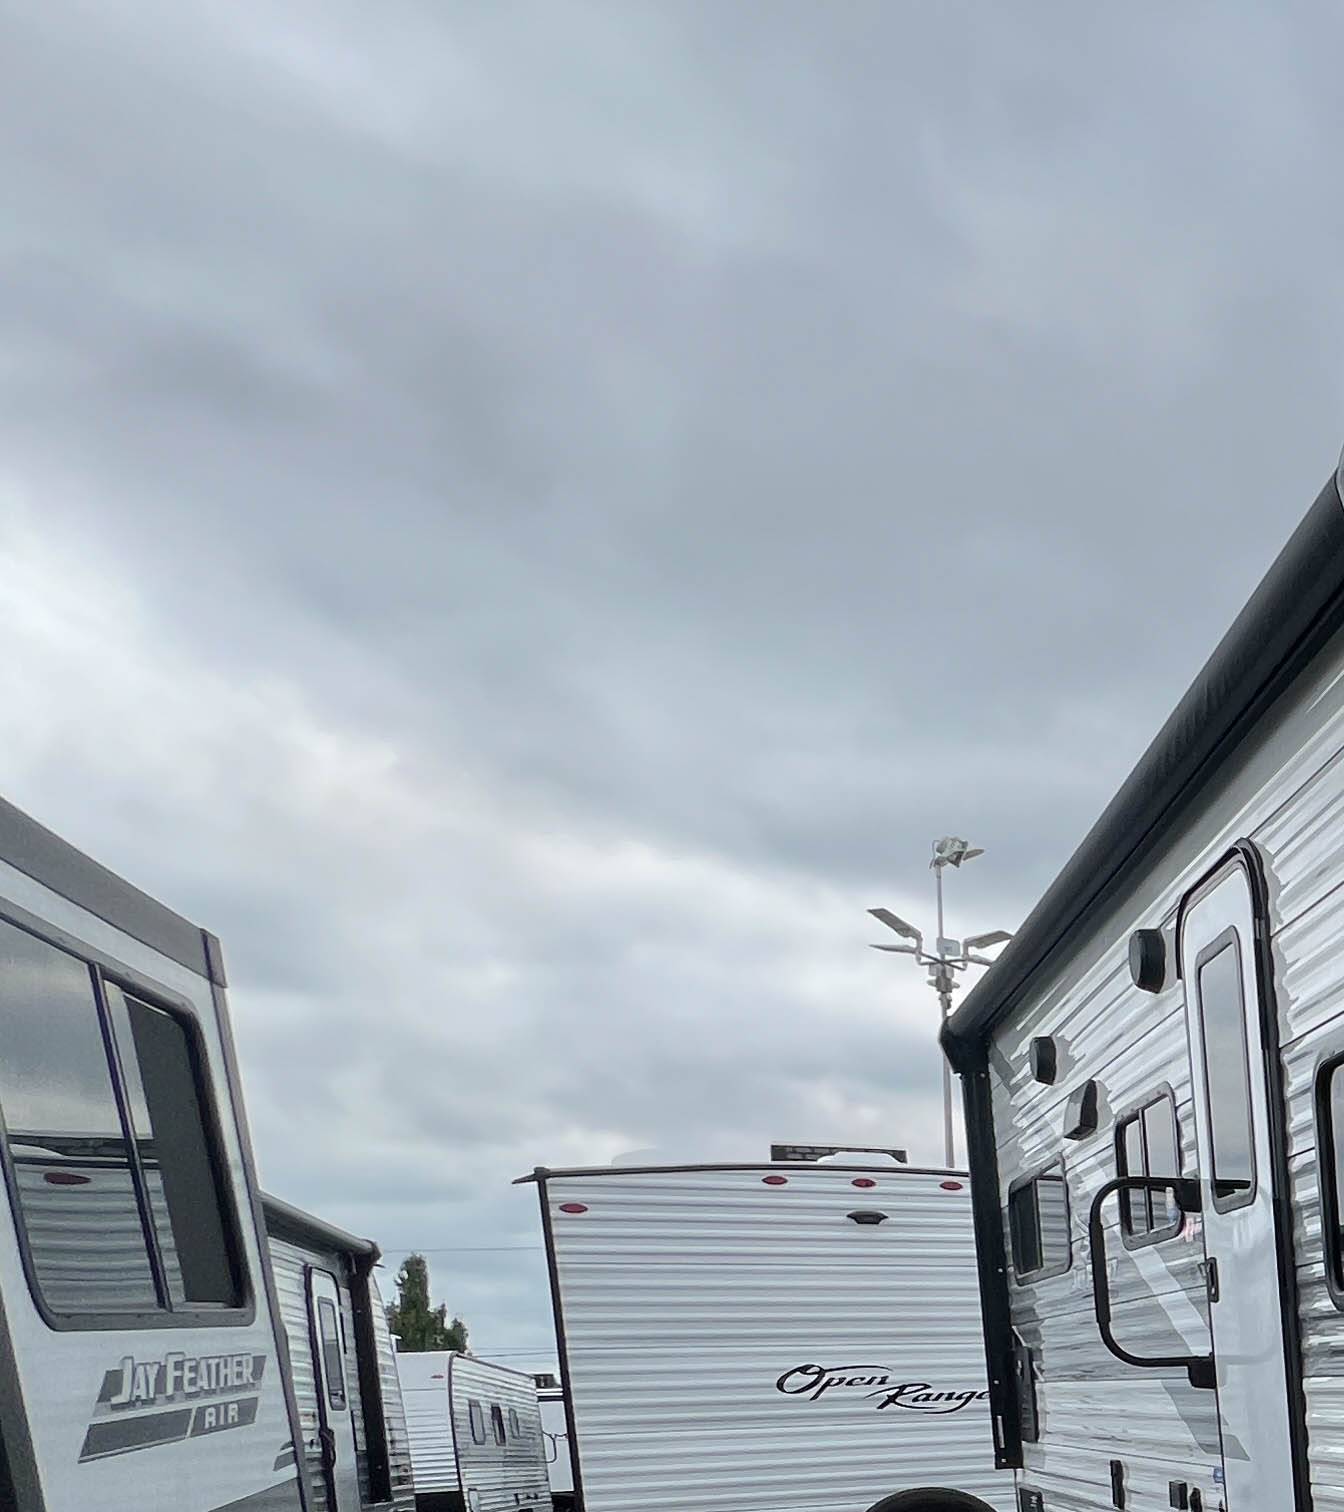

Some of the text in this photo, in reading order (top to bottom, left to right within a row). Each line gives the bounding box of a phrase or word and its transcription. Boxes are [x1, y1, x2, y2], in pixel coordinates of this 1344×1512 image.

[110, 1355, 161, 1408] JAY
[776, 1364, 894, 1401] Open
[204, 1402, 240, 1430] AIR
